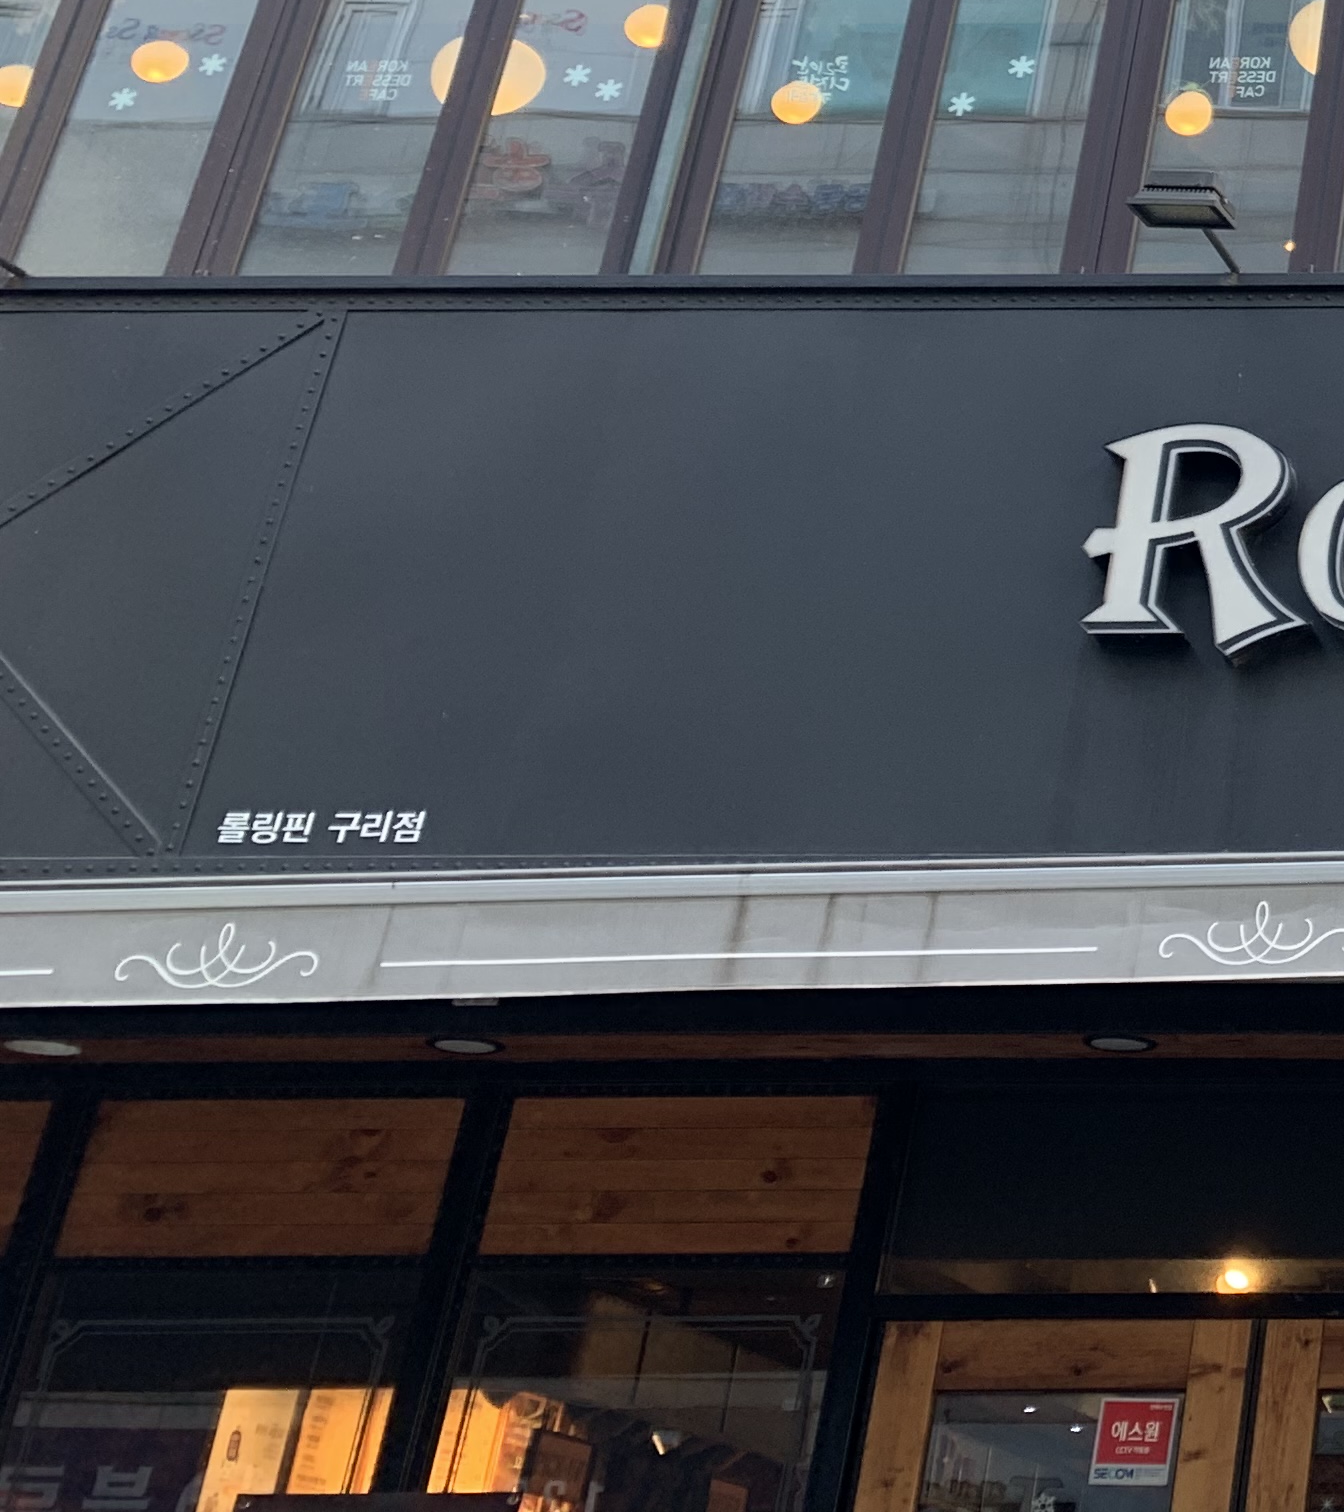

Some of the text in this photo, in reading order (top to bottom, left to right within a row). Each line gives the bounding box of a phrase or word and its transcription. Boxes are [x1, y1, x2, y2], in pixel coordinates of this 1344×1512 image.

[217, 810, 427, 844] 롤링핀 구리점
[1110, 1420, 1160, 1443] 에스원
